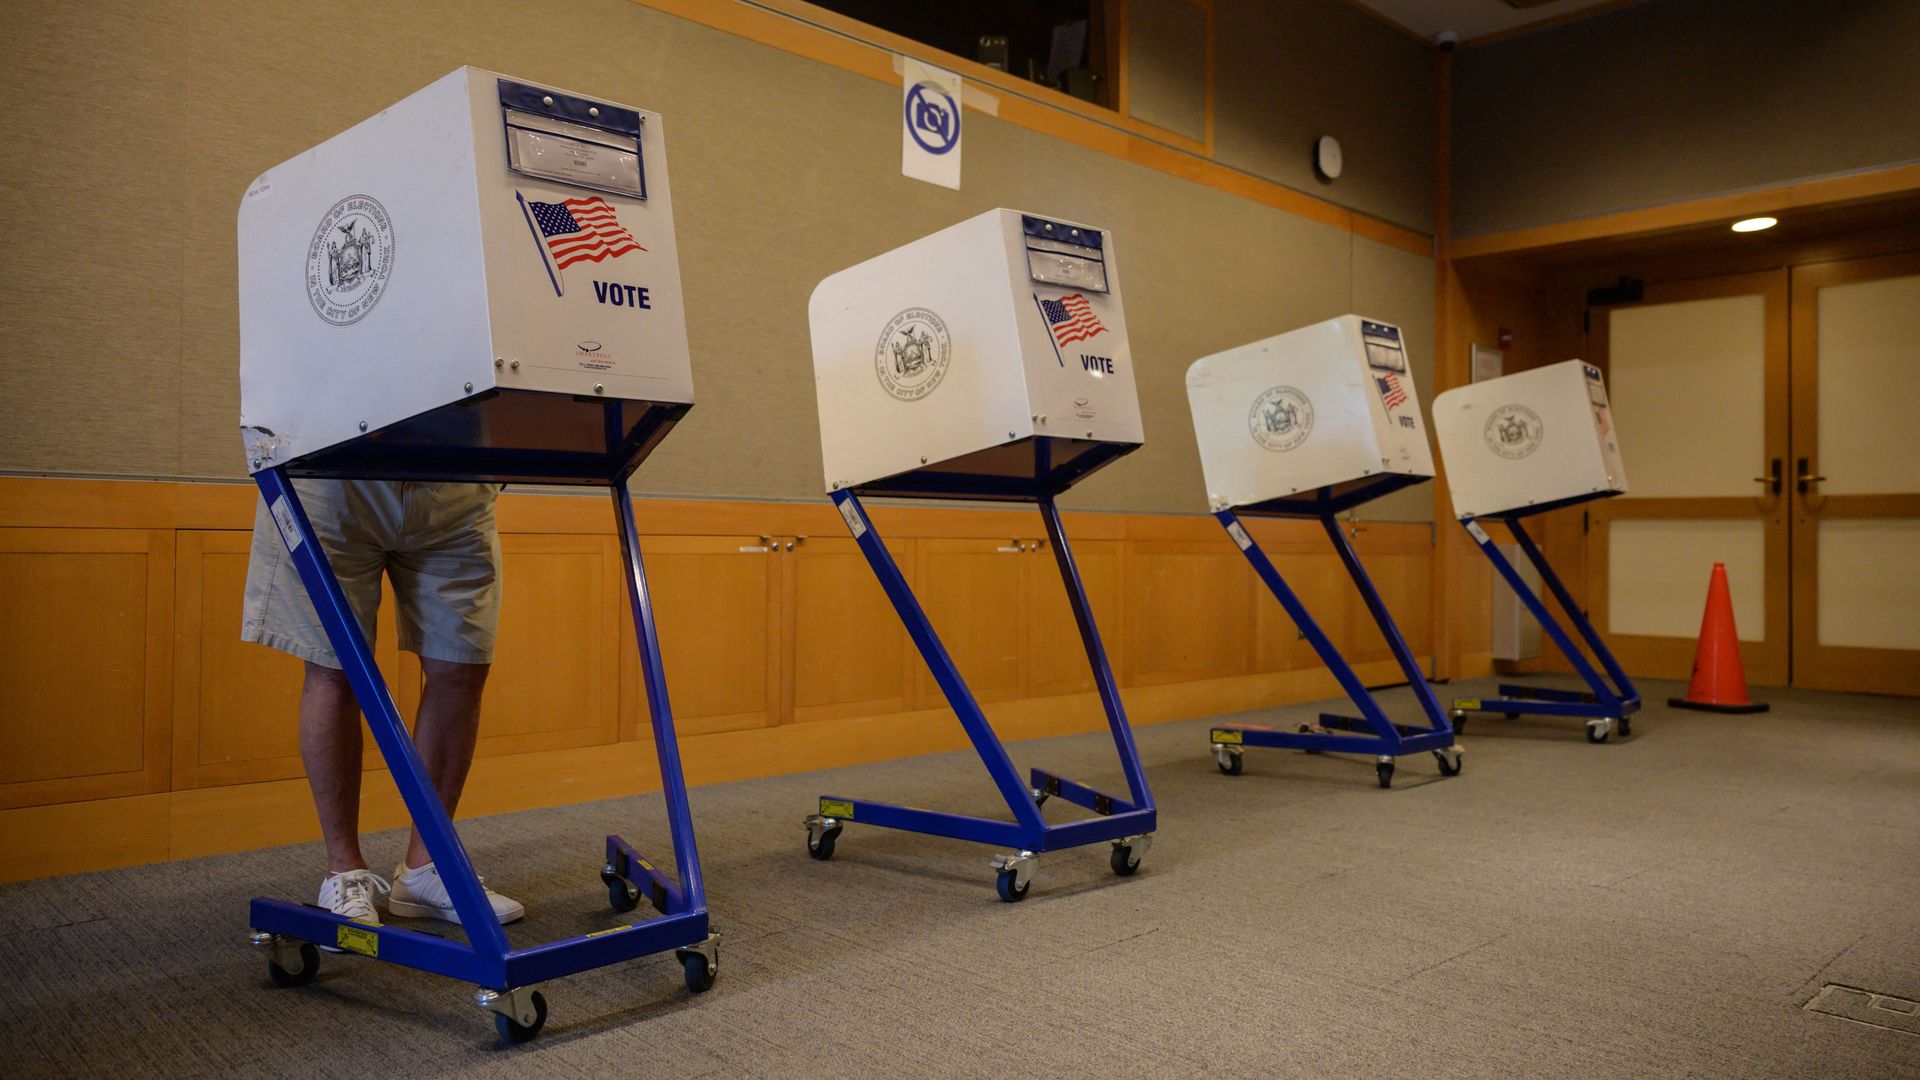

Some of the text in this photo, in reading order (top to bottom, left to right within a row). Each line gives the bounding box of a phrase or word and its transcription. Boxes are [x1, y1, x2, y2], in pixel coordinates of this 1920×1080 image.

[311, 201, 387, 260] BOARD OF ELECTIONS
[378, 245, 391, 280] YORK
[310, 274, 317, 288] IN
[313, 288, 326, 310] THE
[362, 283, 380, 309] NEW
[593, 280, 651, 310] VOTE
[326, 307, 347, 319] CITY
[348, 305, 360, 318] OF
[1080, 354, 1114, 374] VOTE
[896, 389, 914, 397] CITY
[915, 386, 925, 396] OF
